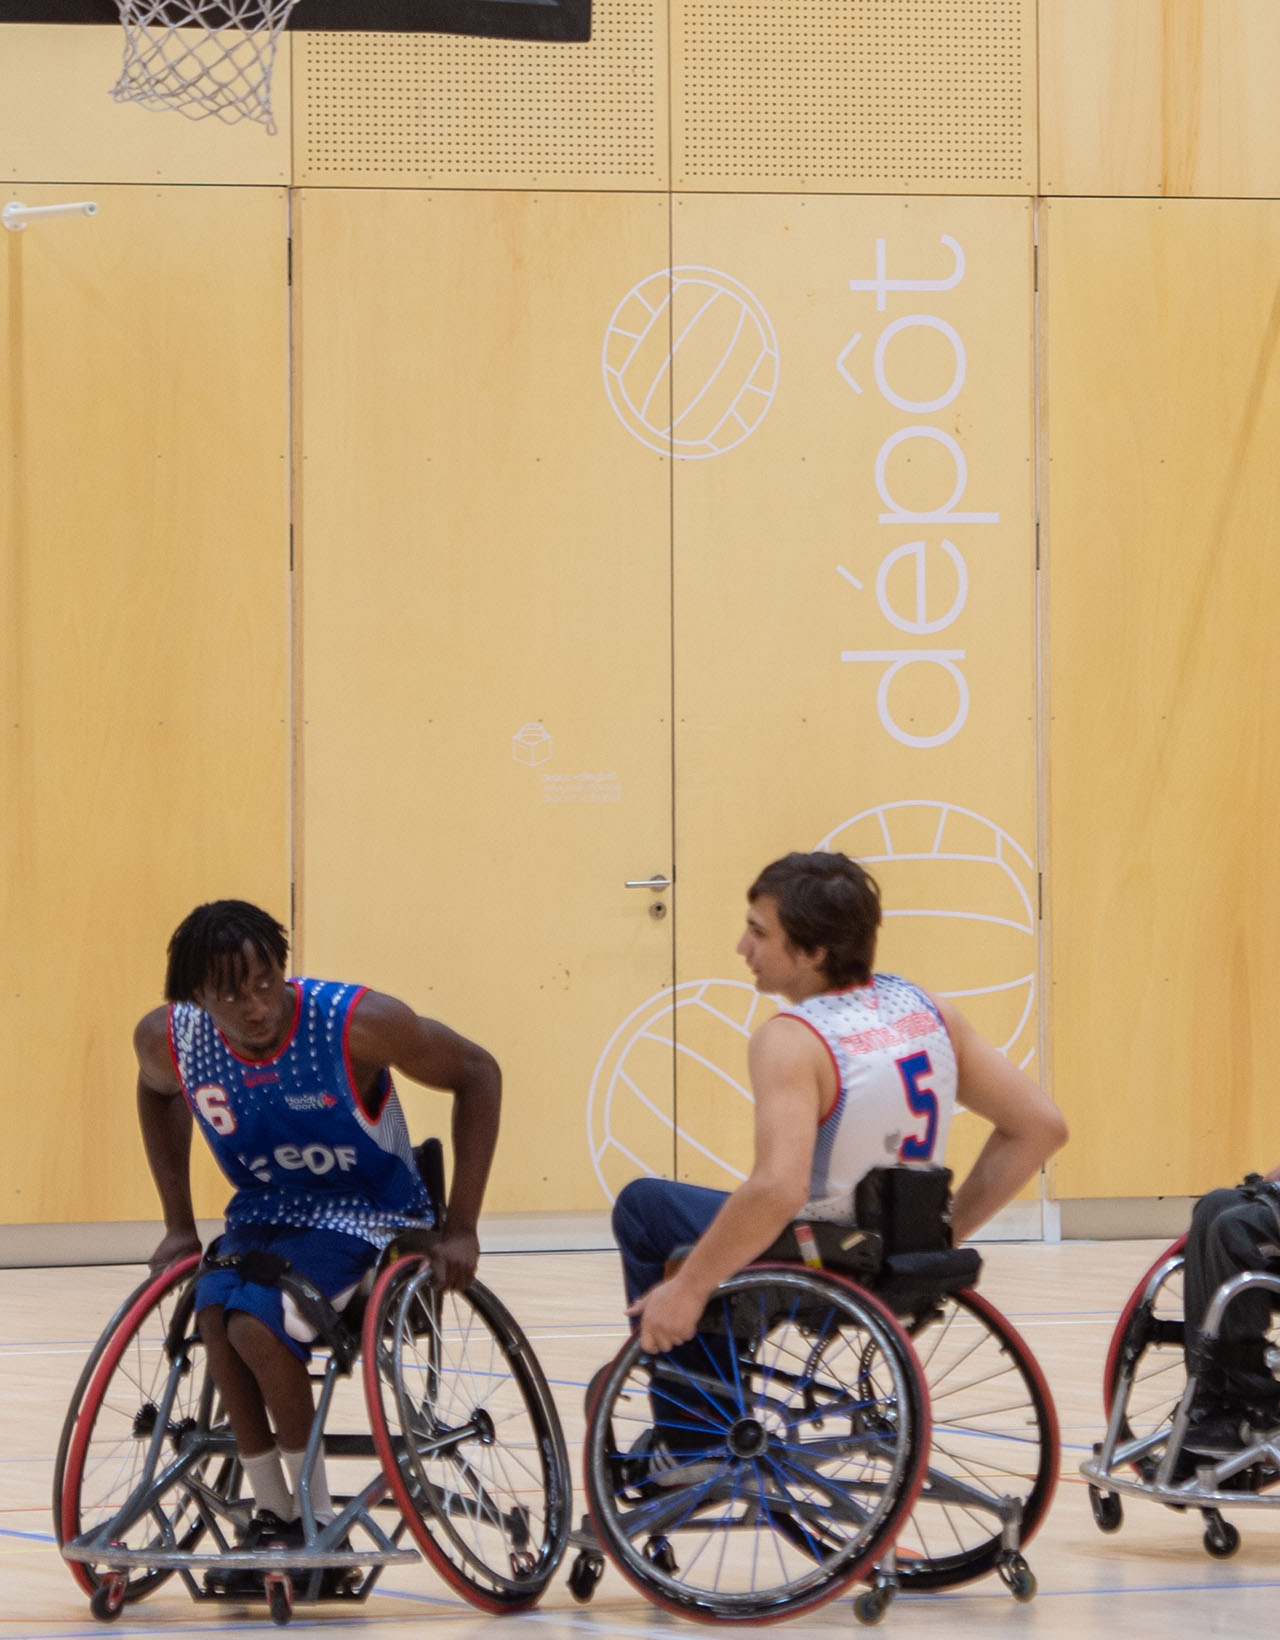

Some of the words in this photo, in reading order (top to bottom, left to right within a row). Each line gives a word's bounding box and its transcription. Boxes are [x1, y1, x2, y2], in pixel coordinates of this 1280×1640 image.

[835, 233, 1000, 749] dépôt
[195, 1087, 237, 1136] 6
[894, 1050, 939, 1162] 5
